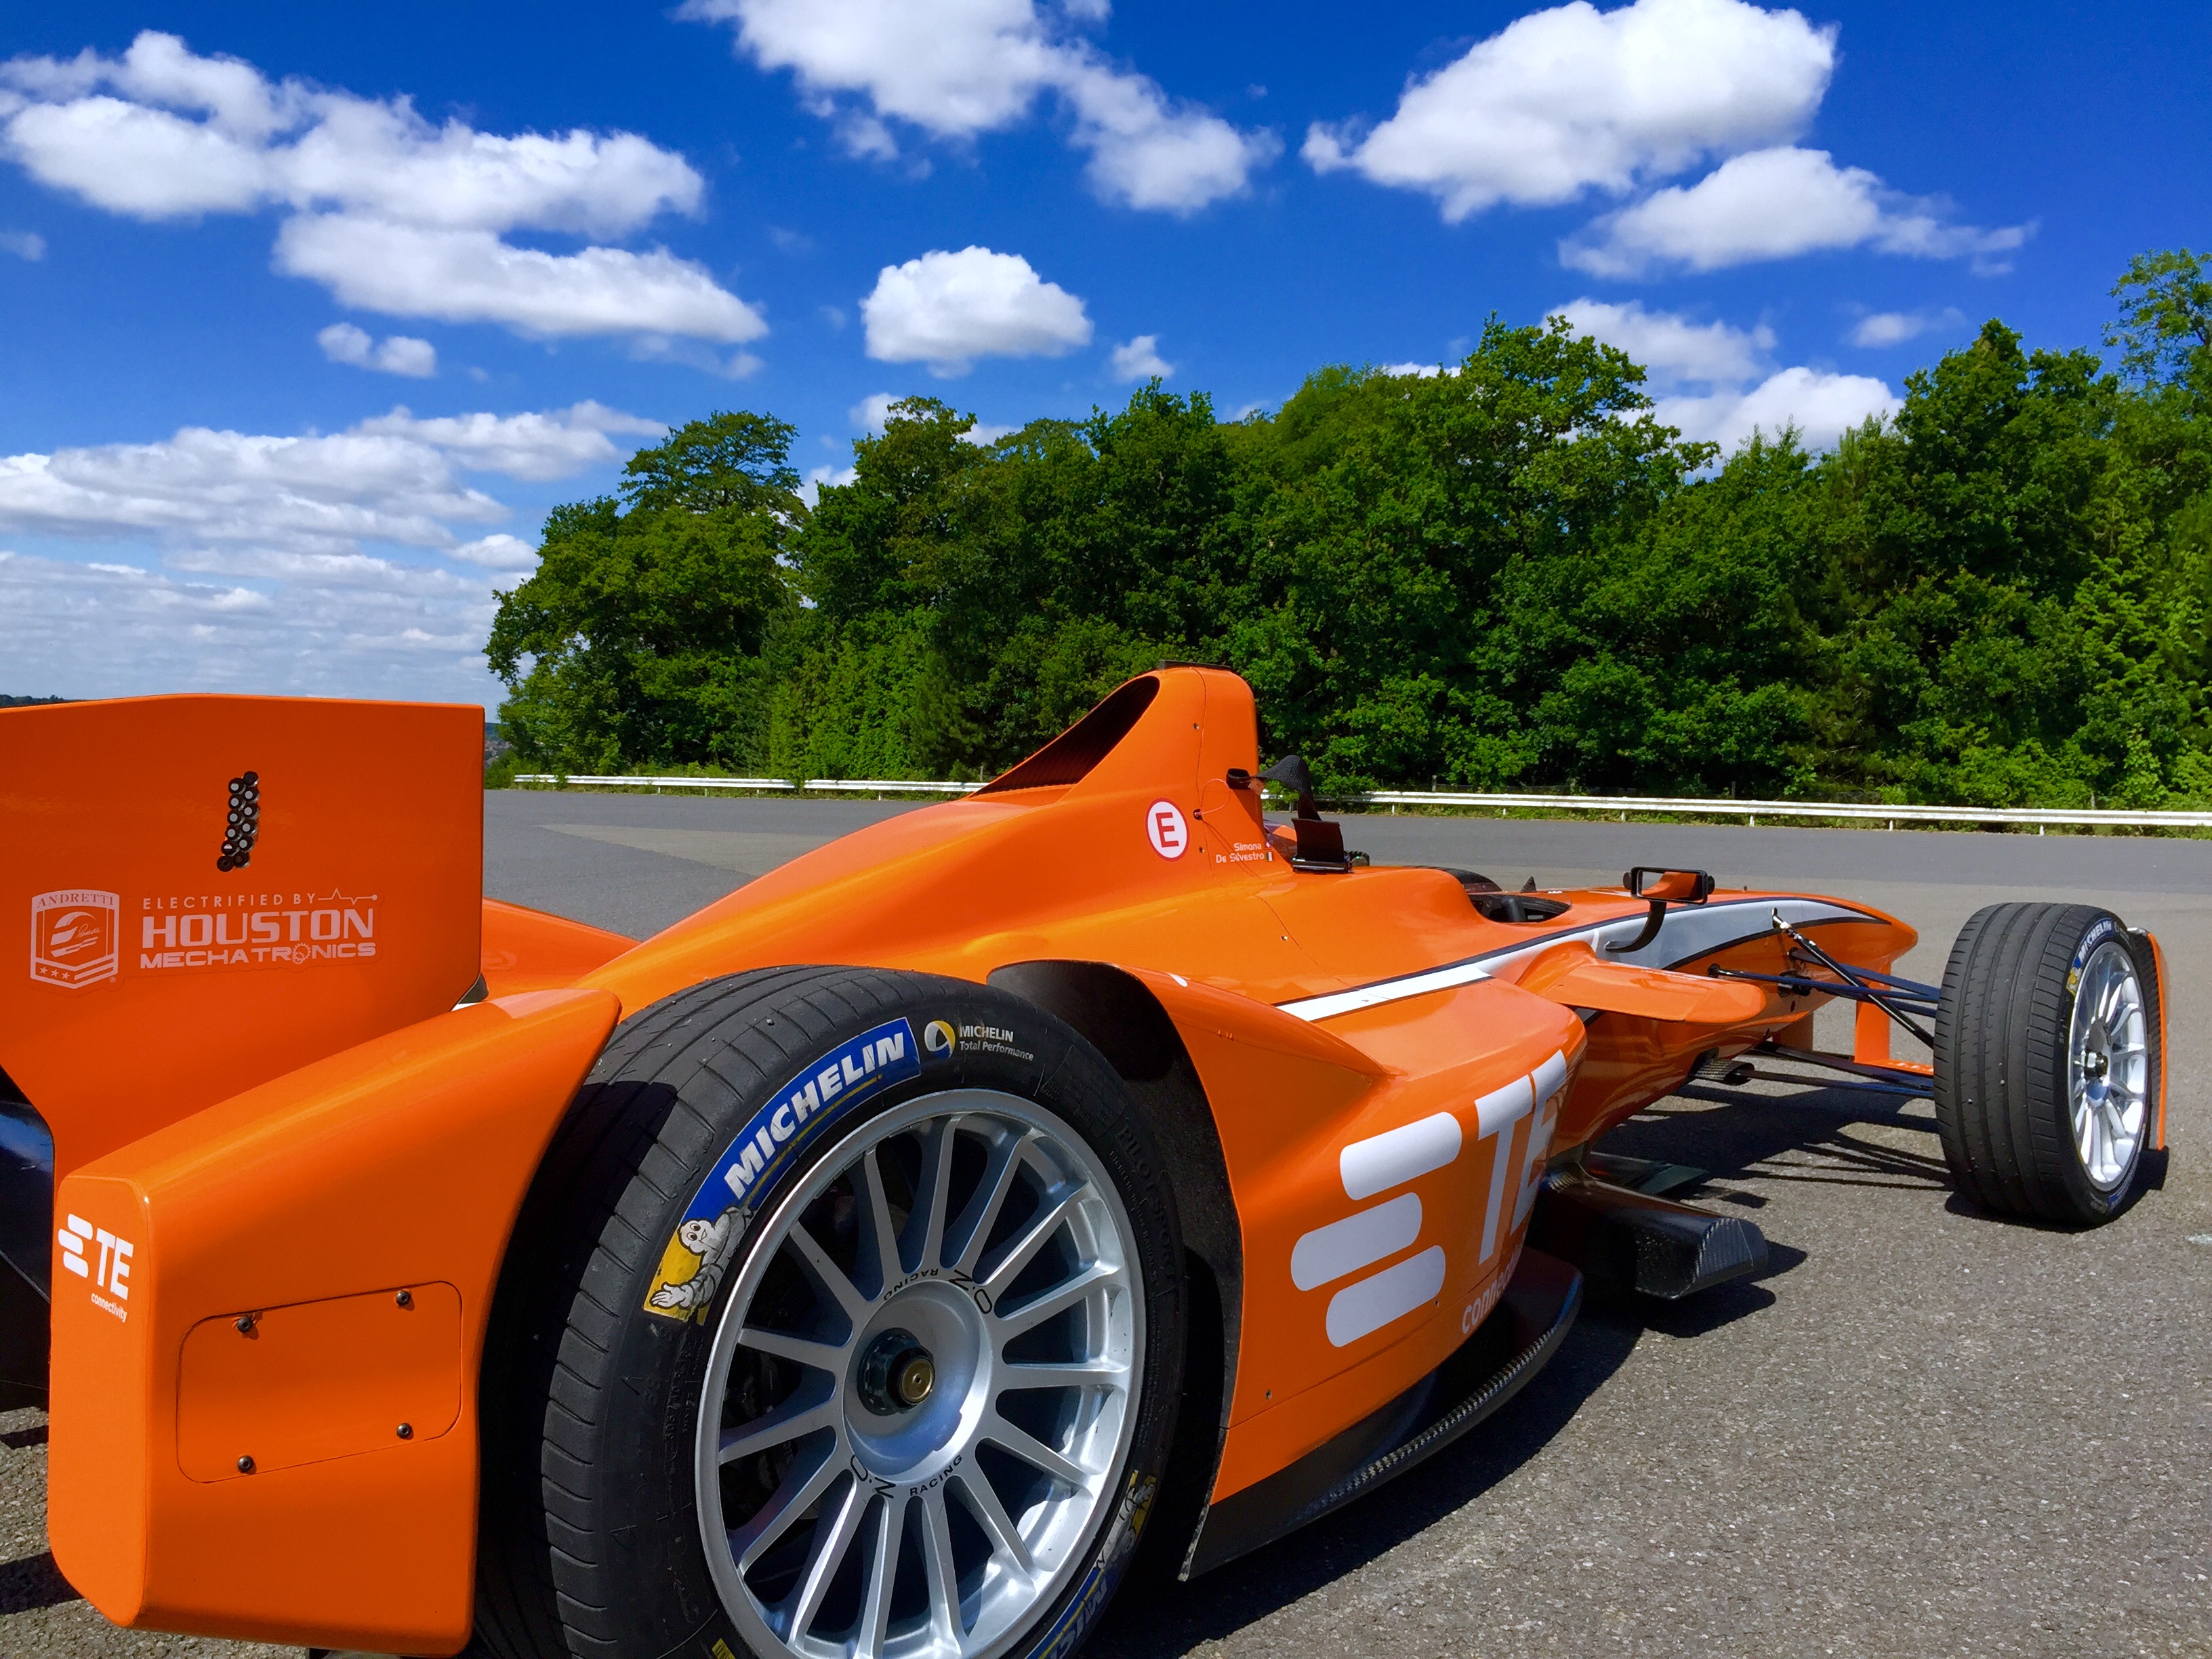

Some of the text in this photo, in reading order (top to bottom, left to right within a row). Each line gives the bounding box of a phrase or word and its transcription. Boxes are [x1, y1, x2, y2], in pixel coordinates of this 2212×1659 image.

[1155, 812, 1179, 848] E
[1216, 851, 1265, 863] De Silvestro
[1233, 842, 1262, 852] Simona
[37, 893, 113, 908] ANDRETTI
[143, 893, 315, 909] ELECTRIFIED BY
[142, 908, 373, 949] HOUSTON
[2078, 920, 2112, 964] MICHELIN
[140, 942, 376, 969] MECHATRONICS
[959, 1025, 1014, 1042] MICHELIN
[960, 1040, 1034, 1061] Total Performance
[724, 1031, 905, 1200] MICHELIN
[1475, 1049, 1567, 1265] TE
[96, 1227, 134, 1300] TE
[884, 1268, 939, 1300] RACING
[91, 1293, 127, 1323] connectivity
[909, 1454, 962, 1496] RACING
